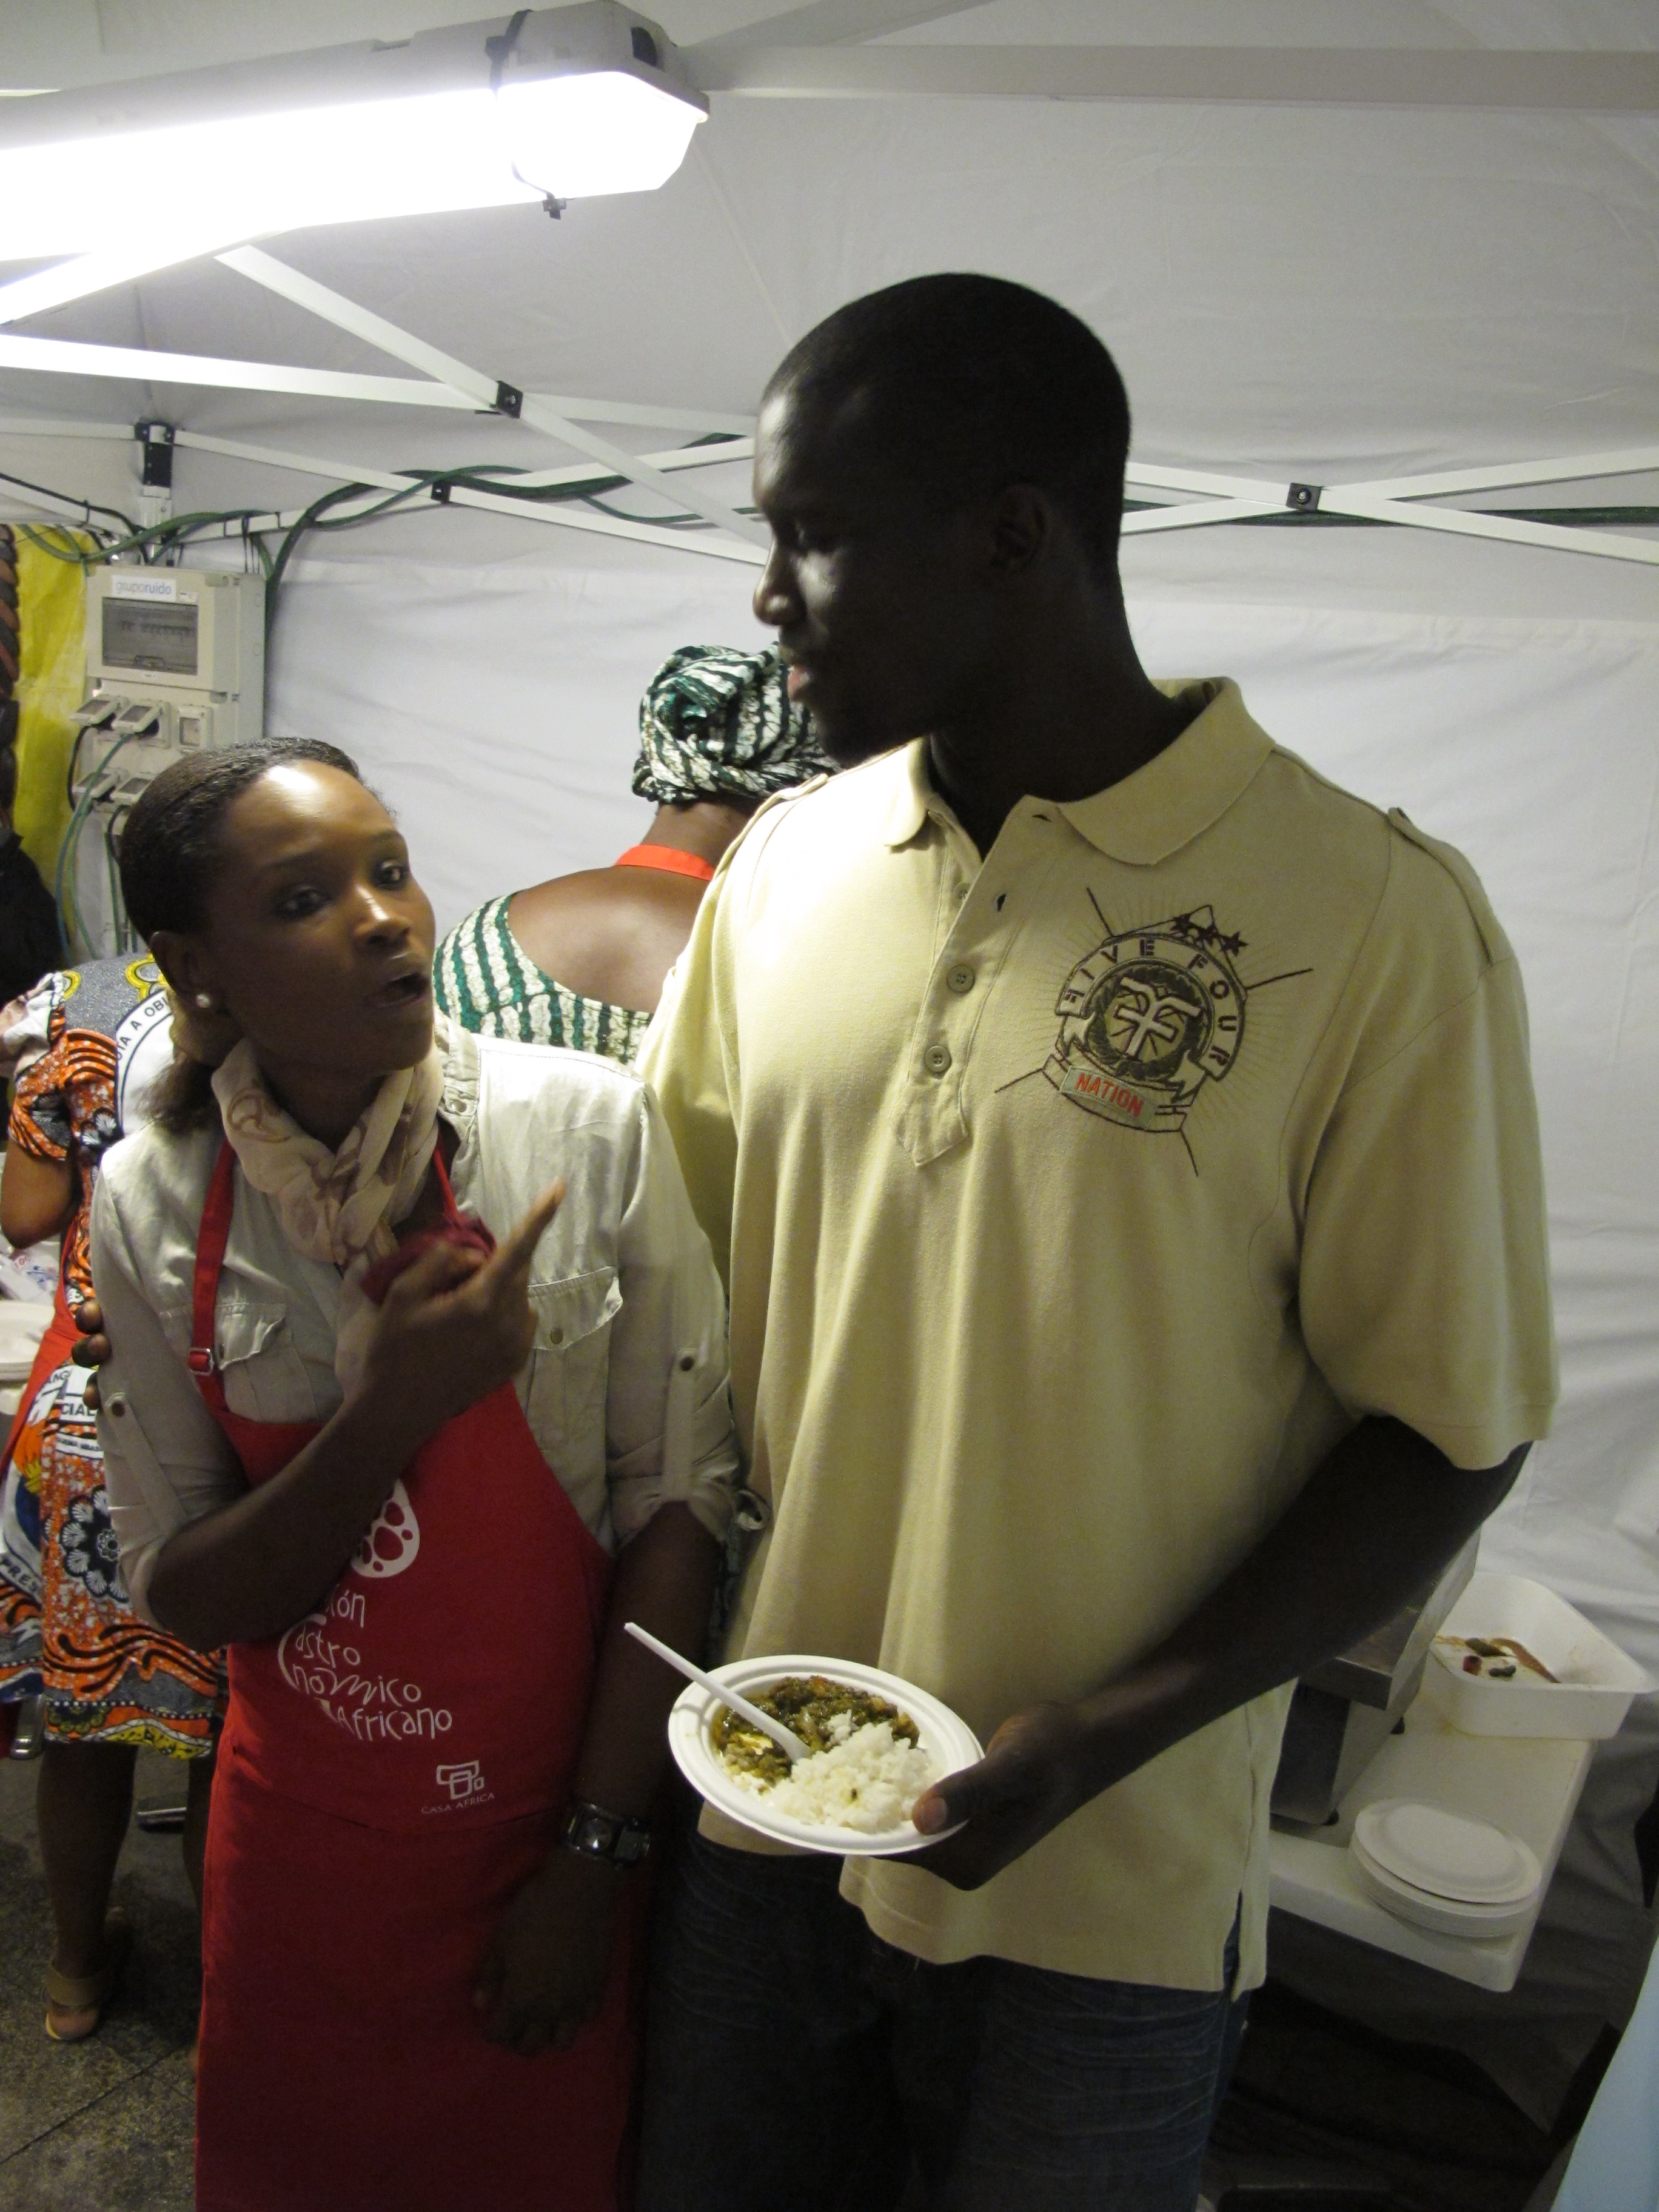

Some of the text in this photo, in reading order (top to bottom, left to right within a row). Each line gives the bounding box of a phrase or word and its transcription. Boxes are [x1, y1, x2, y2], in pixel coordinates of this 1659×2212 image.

[1064, 939, 1238, 1066] FIVE FOUR
[1074, 1072, 1145, 1118] NATION
[336, 1706, 452, 1741] Africano
[421, 1792, 495, 1814] CASA AFRICA
